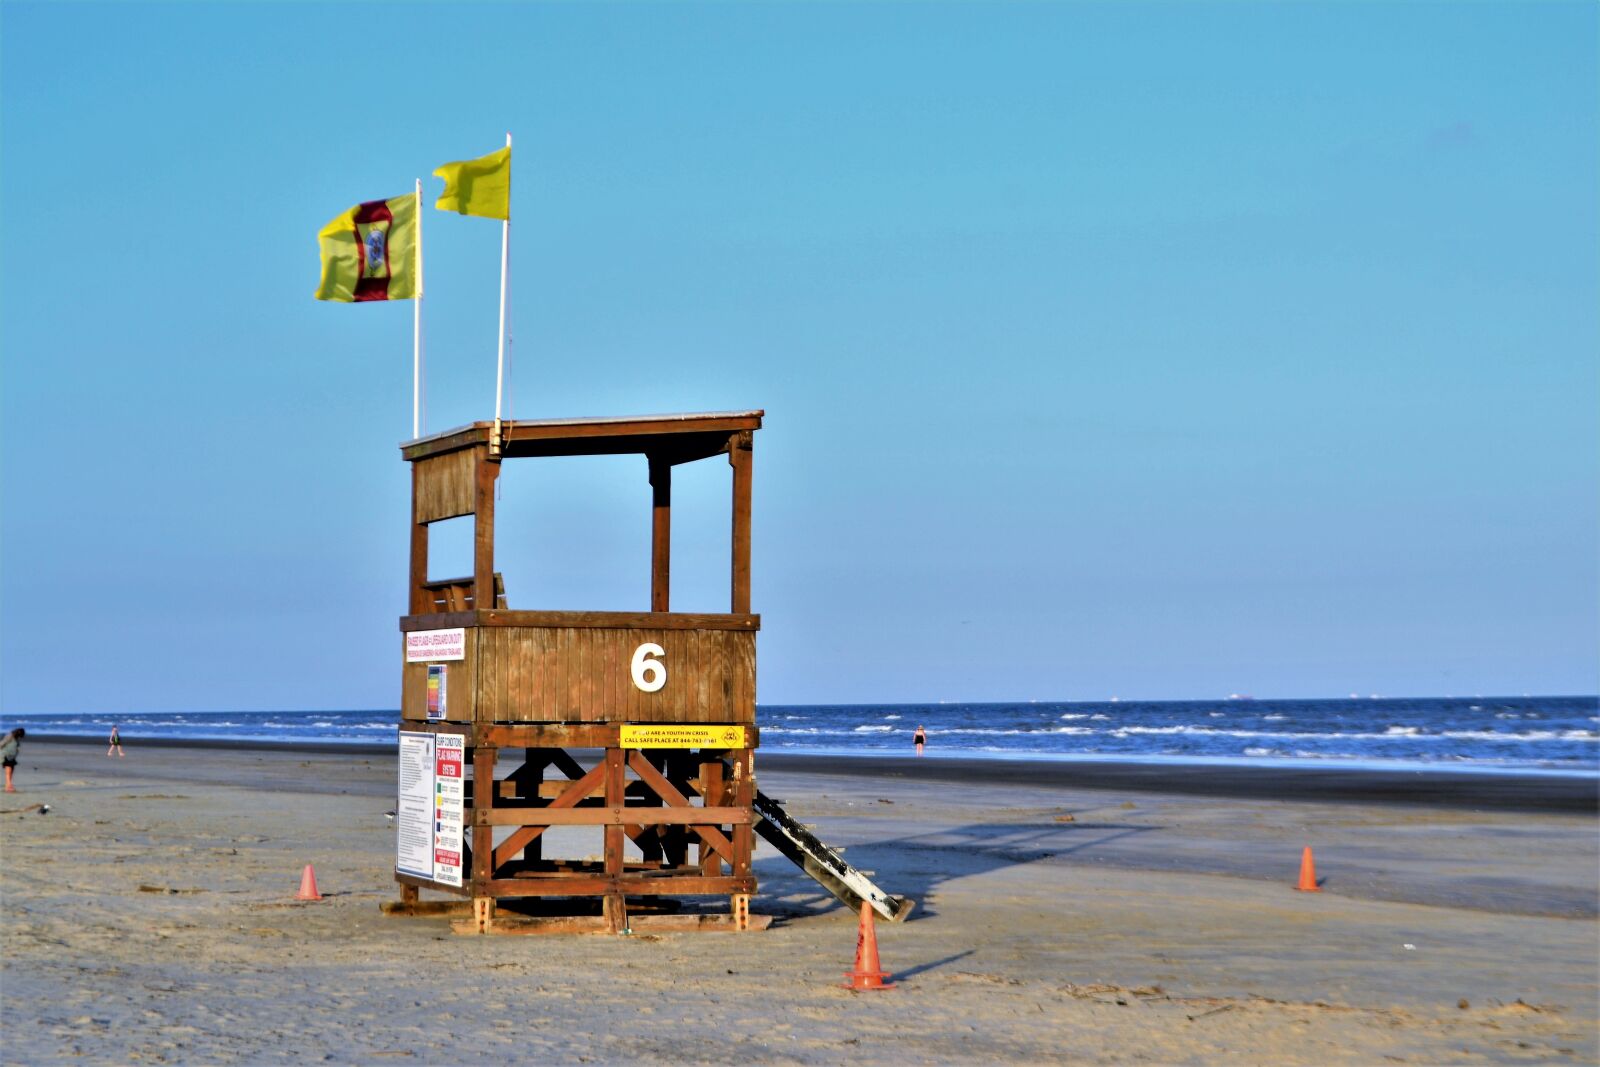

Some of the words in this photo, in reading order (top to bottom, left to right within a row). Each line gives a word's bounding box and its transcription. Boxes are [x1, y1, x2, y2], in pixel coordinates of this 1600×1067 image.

[631, 642, 666, 692] 6
[445, 737, 462, 747] CONDITIONS
[437, 750, 446, 761] FLAG
[447, 750, 461, 762] WARNING
[442, 763, 456, 776] SYSTEM
